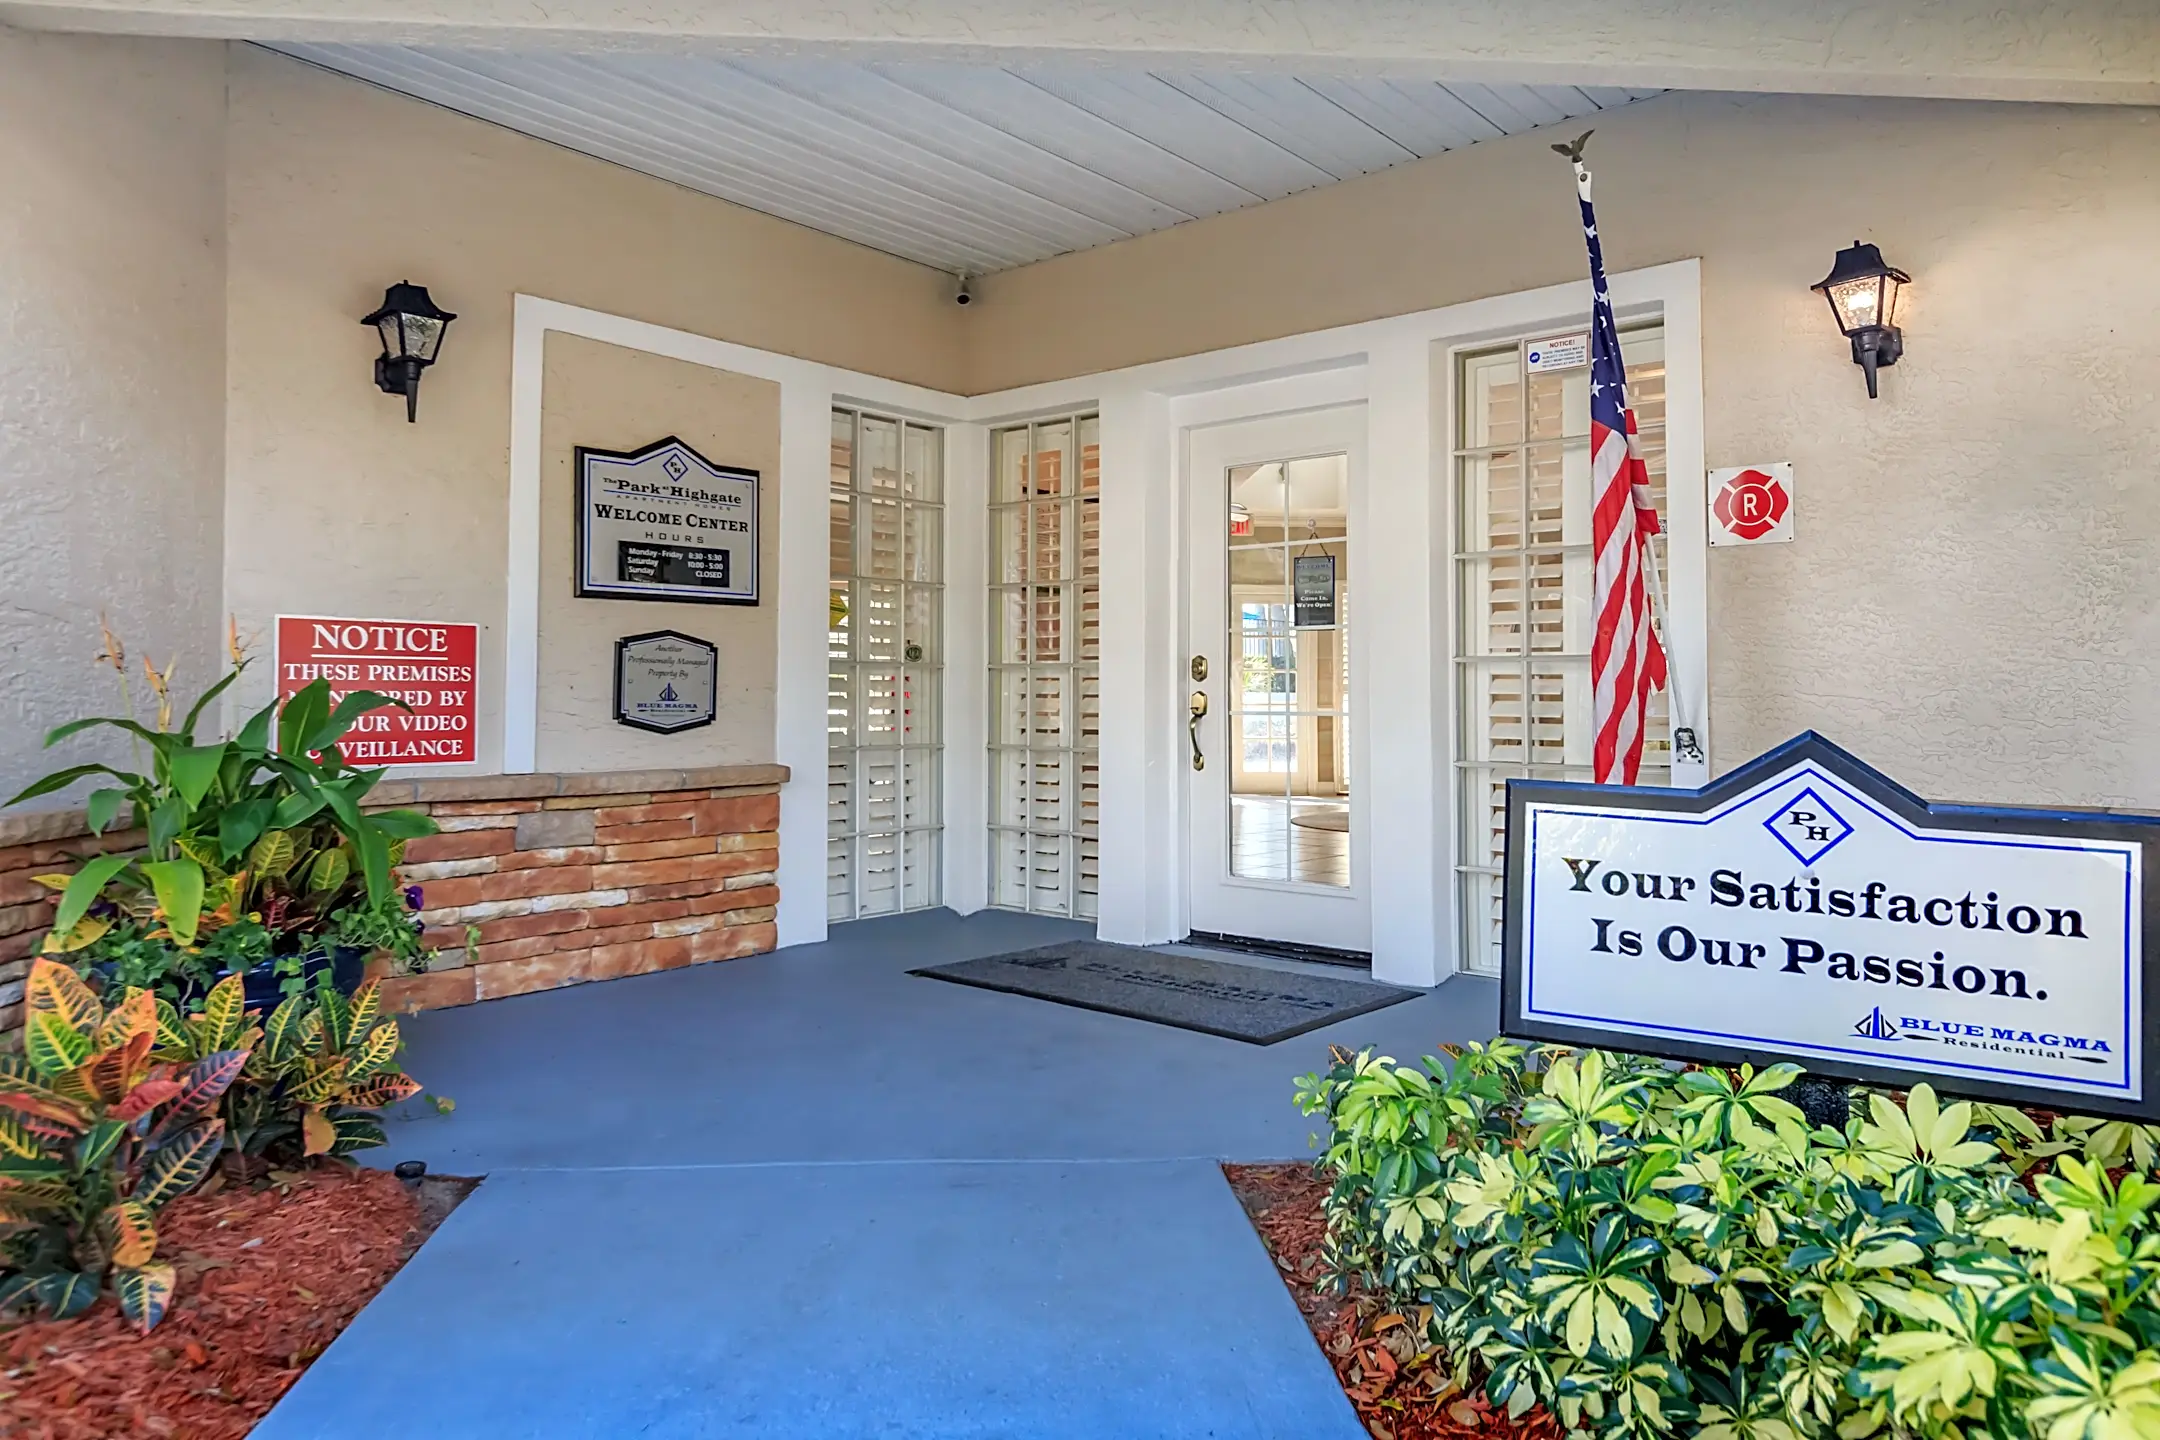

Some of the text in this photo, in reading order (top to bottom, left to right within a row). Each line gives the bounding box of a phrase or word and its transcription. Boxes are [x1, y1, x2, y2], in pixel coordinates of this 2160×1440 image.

[1549, 340, 1575, 348] NOTICE!
[603, 477, 618, 485] The
[617, 479, 661, 495] Park
[670, 486, 742, 504] Highgate
[1743, 493, 1758, 517] R
[594, 503, 749, 533] WELCOME CENTER
[645, 531, 704, 544] HOURS
[627, 556, 659, 568] Saturday
[628, 547, 658, 558] Monday
[661, 550, 684, 560] Friday
[628, 565, 723, 579] Sunday CLOSED
[312, 624, 448, 652] NOTICE
[284, 663, 472, 682] THESE PREMISES
[439, 690, 468, 706] BY
[346, 714, 468, 733] UR VIDEO
[304, 740, 463, 759] VEILLANCE
[1788, 811, 1817, 826] P
[1804, 826, 1831, 841] H
[1562, 857, 2090, 939] Your Satisfaction
[1590, 917, 2048, 1001] Is Our Passion.
[1899, 1016, 2113, 1053] BLUE MAGMA
[1943, 1036, 2066, 1060] Residential
